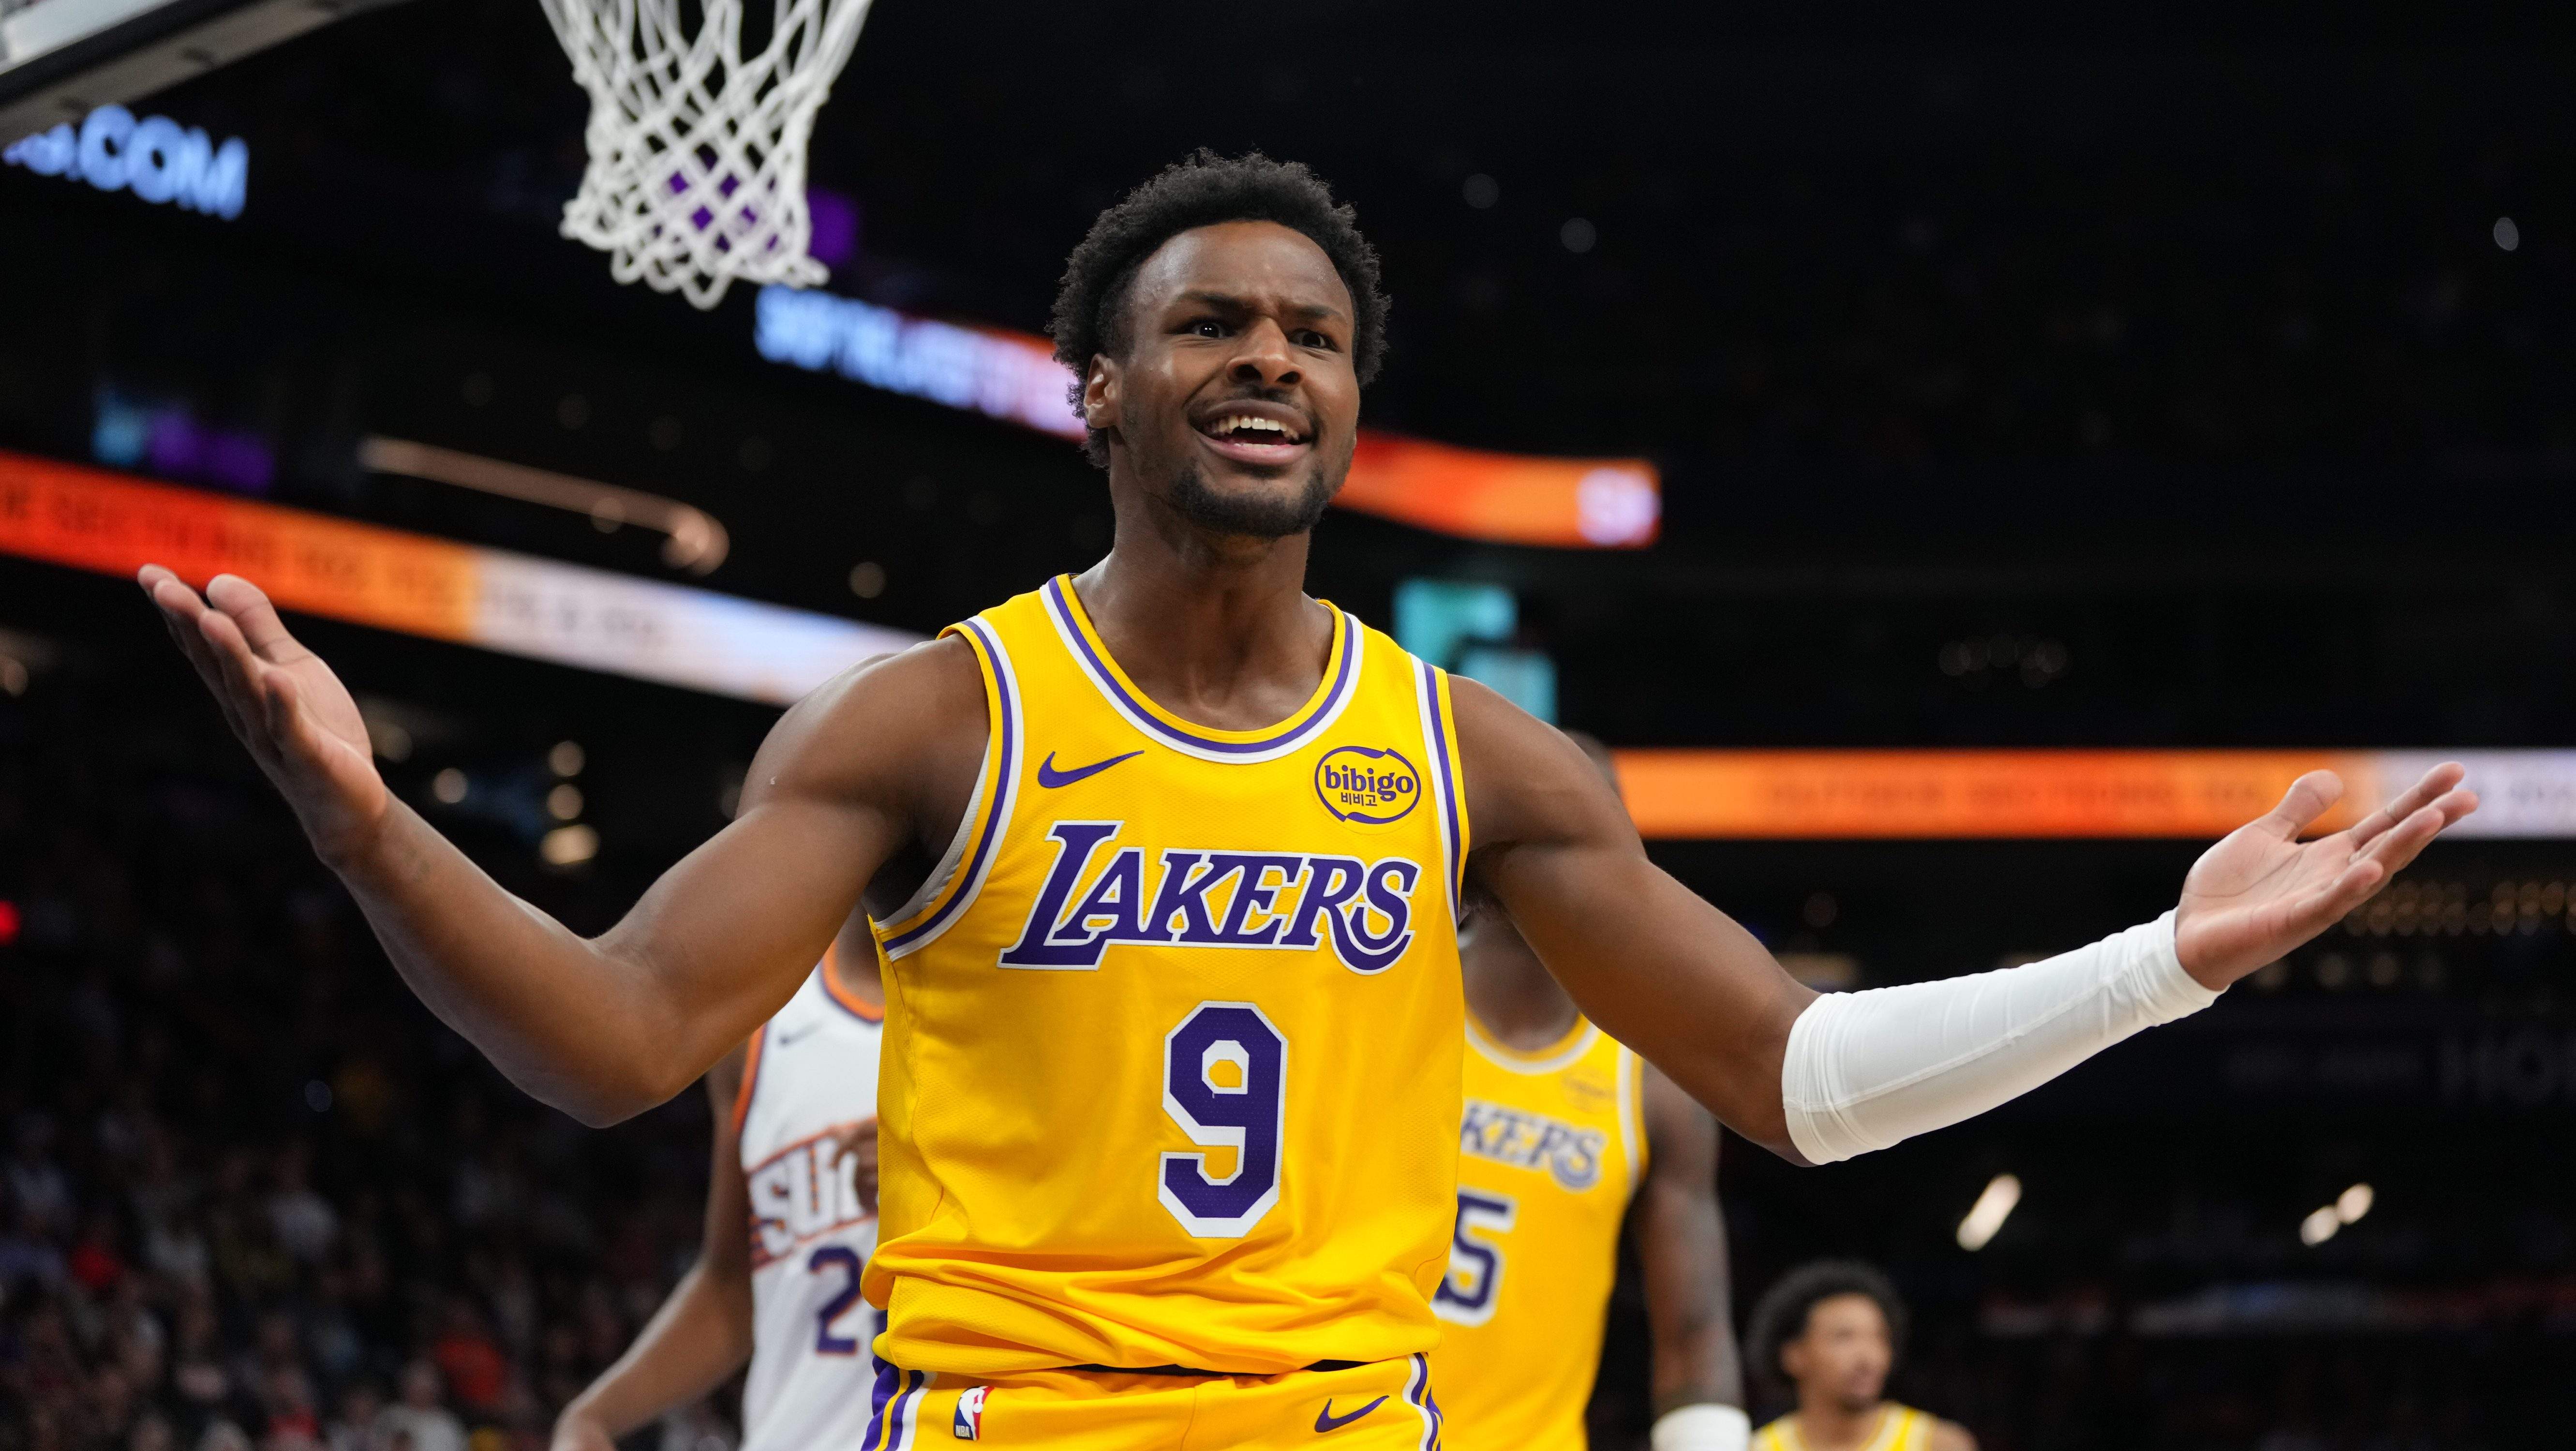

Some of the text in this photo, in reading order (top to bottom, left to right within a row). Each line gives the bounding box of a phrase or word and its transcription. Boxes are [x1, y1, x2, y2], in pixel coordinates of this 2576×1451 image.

[1325, 764, 1414, 802] bibigo
[1340, 792, 1378, 807] 비비고
[997, 820, 1423, 975] LAKERS
[1158, 1000, 1289, 1239] 9
[808, 1242, 888, 1355] 2
[1430, 1187, 1515, 1326] 5
[955, 1425, 970, 1438] NBA
